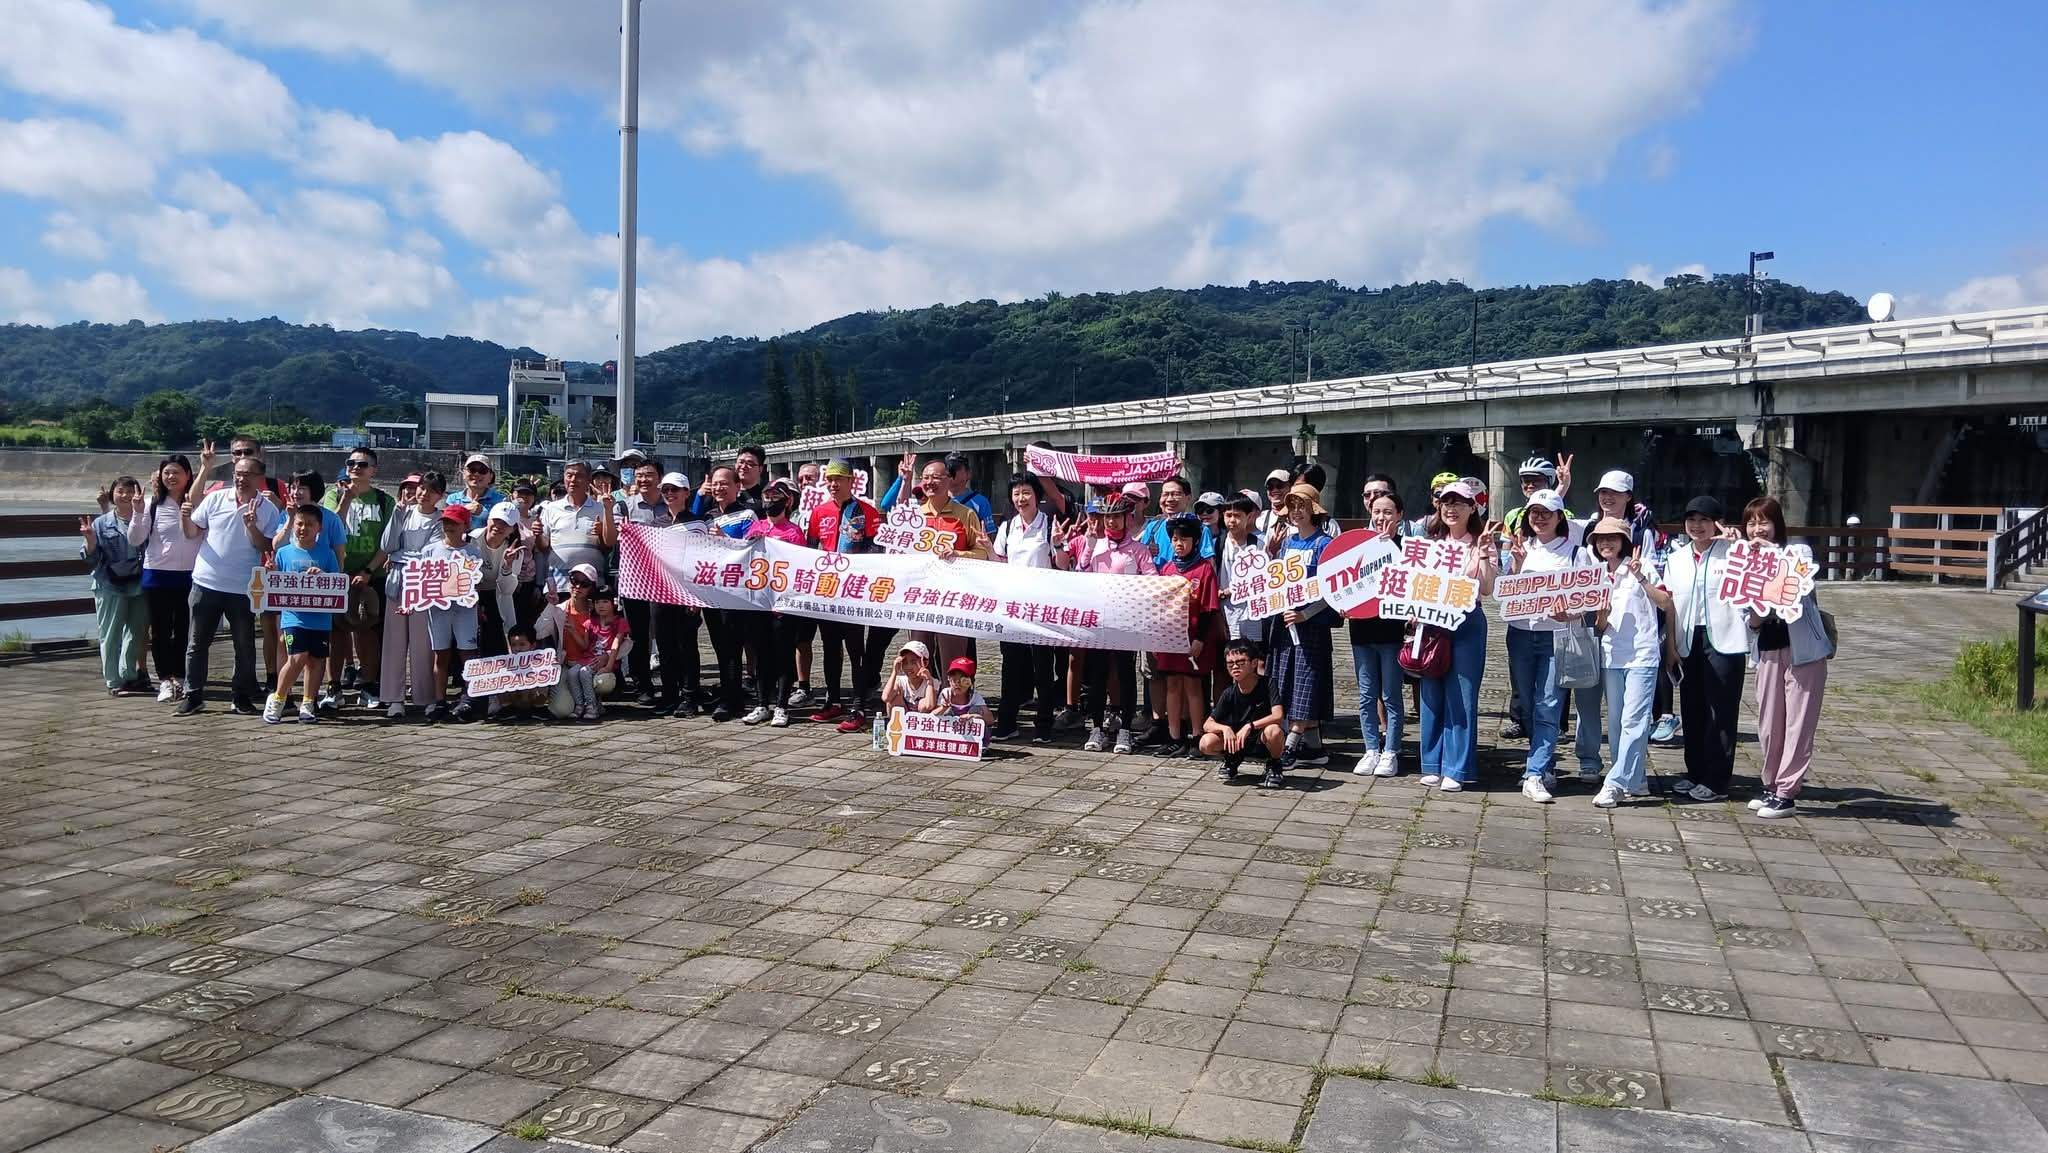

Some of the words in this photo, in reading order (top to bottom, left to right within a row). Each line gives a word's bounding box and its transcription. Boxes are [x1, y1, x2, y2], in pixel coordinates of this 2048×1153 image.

[1360, 552, 1393, 578] BIOPHARM
[1400, 539, 1464, 573] 東洋
[405, 559, 450, 608] 讚
[1232, 555, 1304, 601] 滋骨35
[1378, 566, 1474, 608] 挺健康
[1720, 543, 1779, 613] 讚
[1003, 600, 1101, 628] 東洋挺健康
[1250, 579, 1320, 618] 騎動健骨
[1382, 603, 1461, 627] HEALTHY
